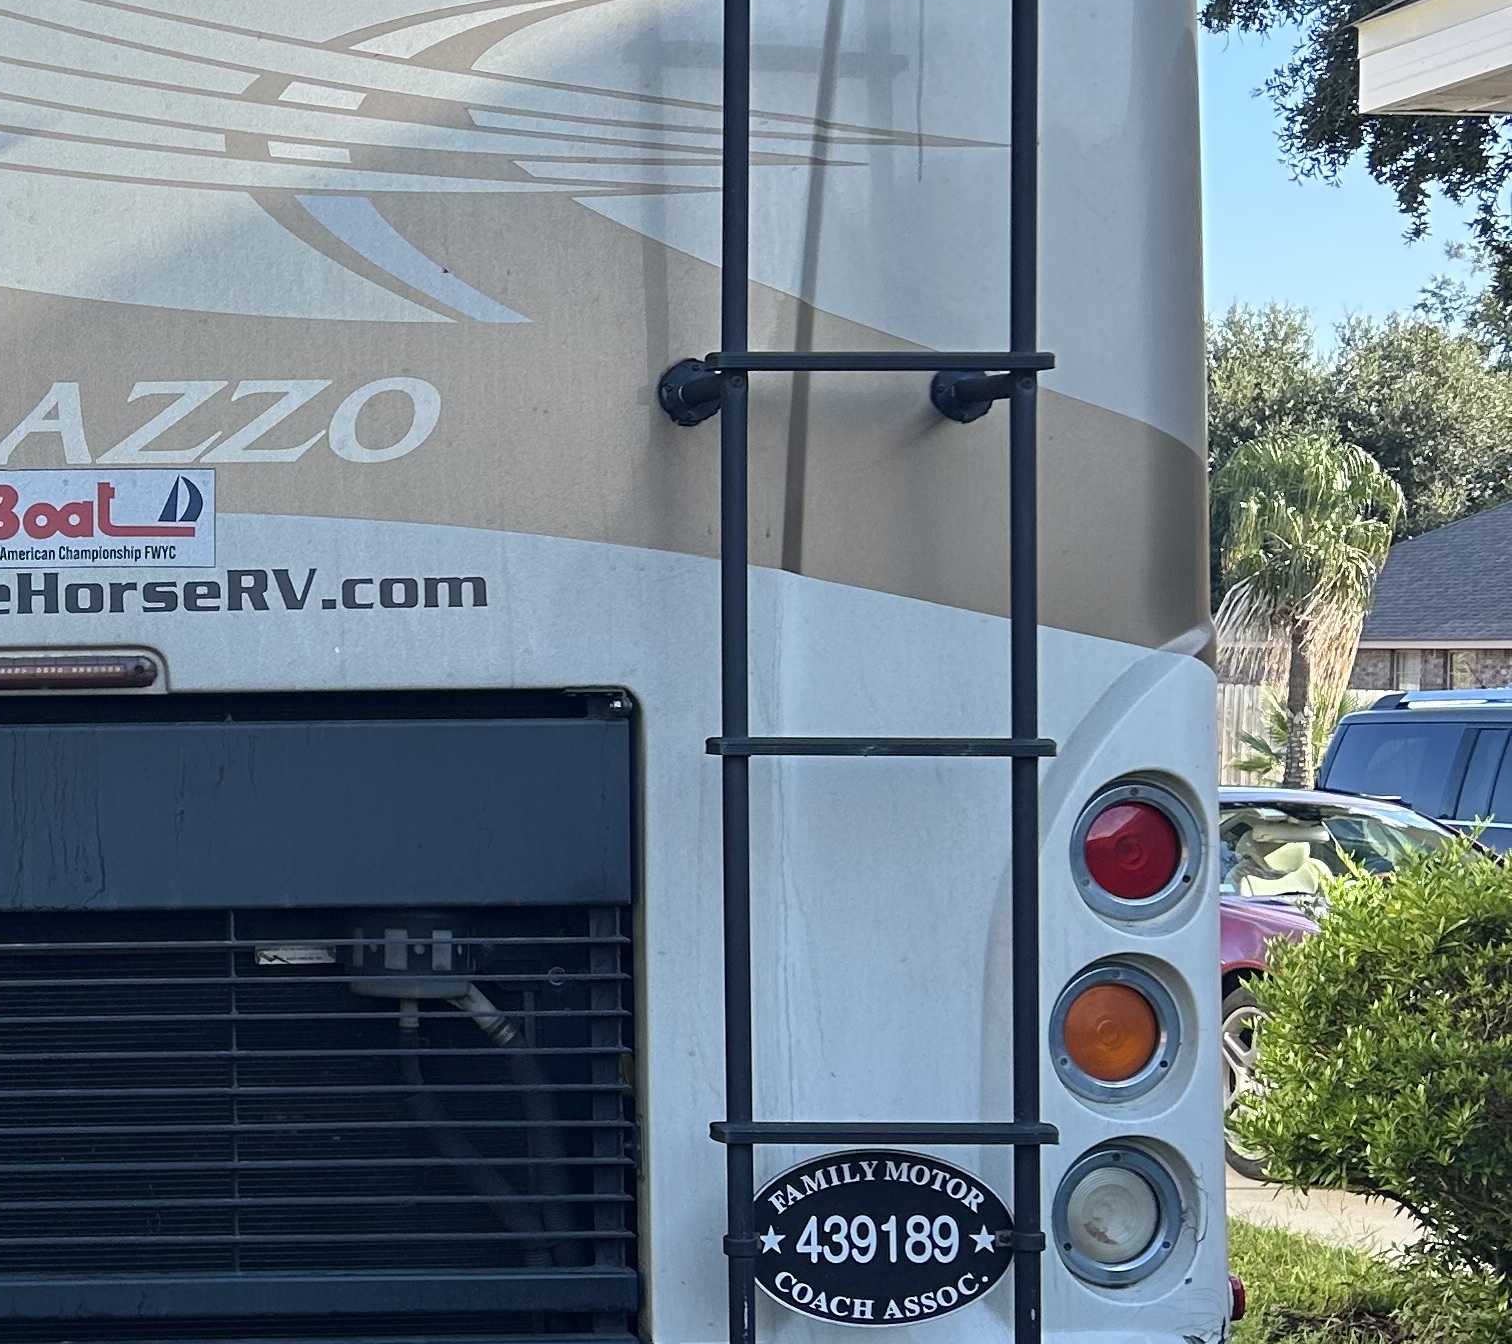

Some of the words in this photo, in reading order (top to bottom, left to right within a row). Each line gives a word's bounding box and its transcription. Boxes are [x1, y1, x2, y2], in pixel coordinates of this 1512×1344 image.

[0, 546, 56, 561] American
[58, 545, 142, 563] Championship
[144, 545, 177, 560] FWYC
[768, 1160, 879, 1215] FAMILY
[883, 1160, 985, 1214] MOTOR
[795, 1214, 960, 1264] 439189
[774, 1271, 875, 1320] COACH
[883, 1272, 989, 1320] ASSOC.
